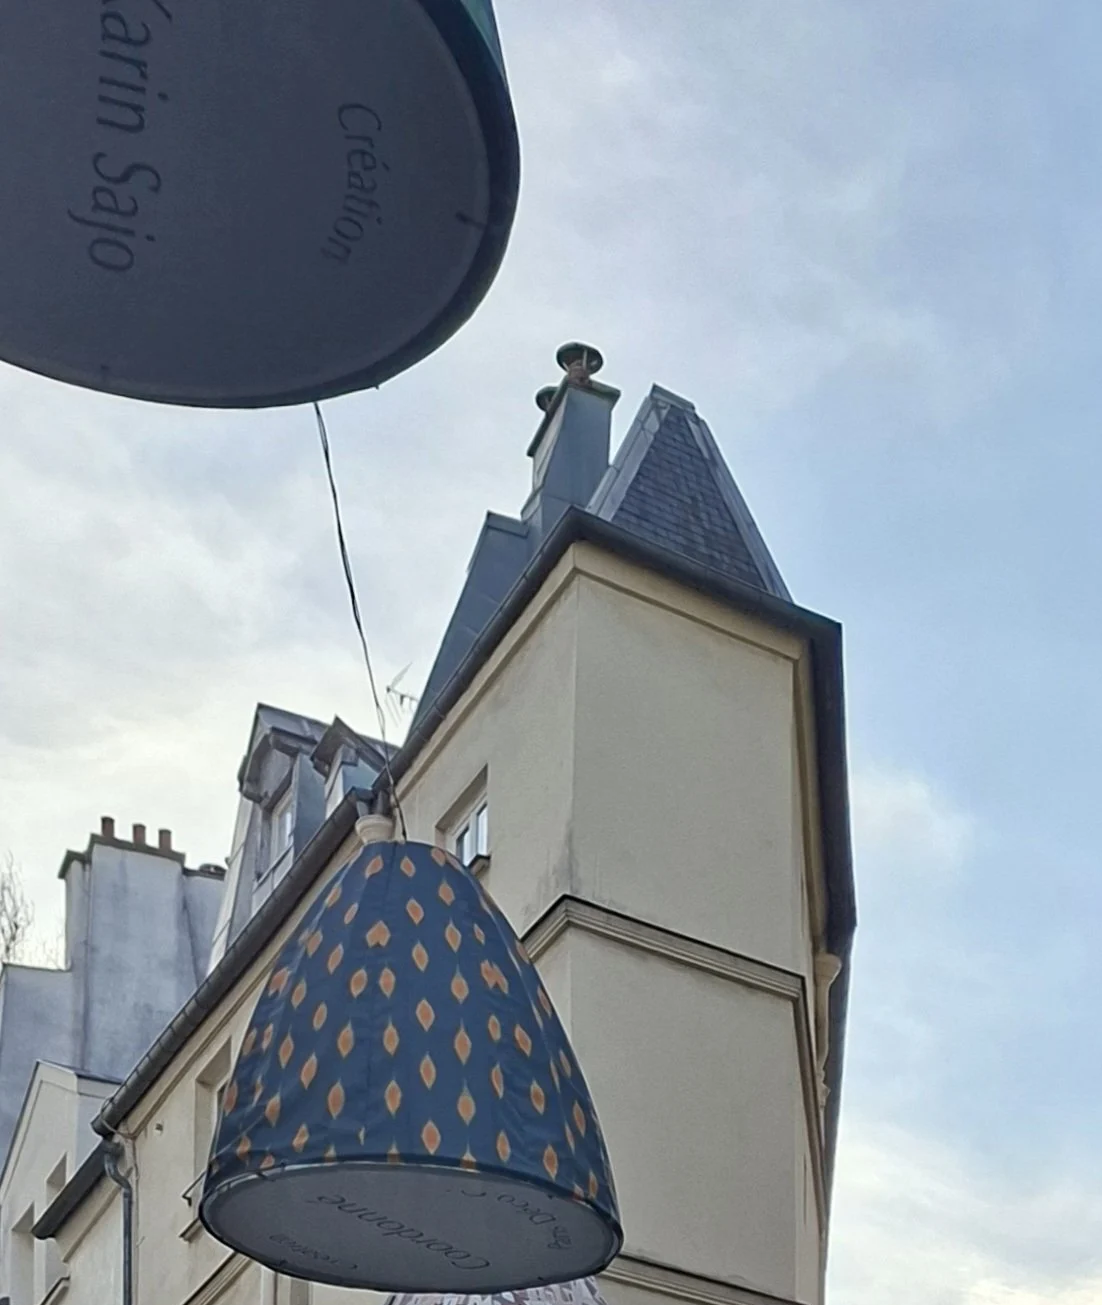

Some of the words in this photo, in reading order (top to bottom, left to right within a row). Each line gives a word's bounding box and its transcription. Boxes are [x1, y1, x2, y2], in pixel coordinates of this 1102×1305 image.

[68, 153, 161, 272] Sajo
[320, 103, 390, 266] Création
[308, 1193, 492, 1270] Coordonné
